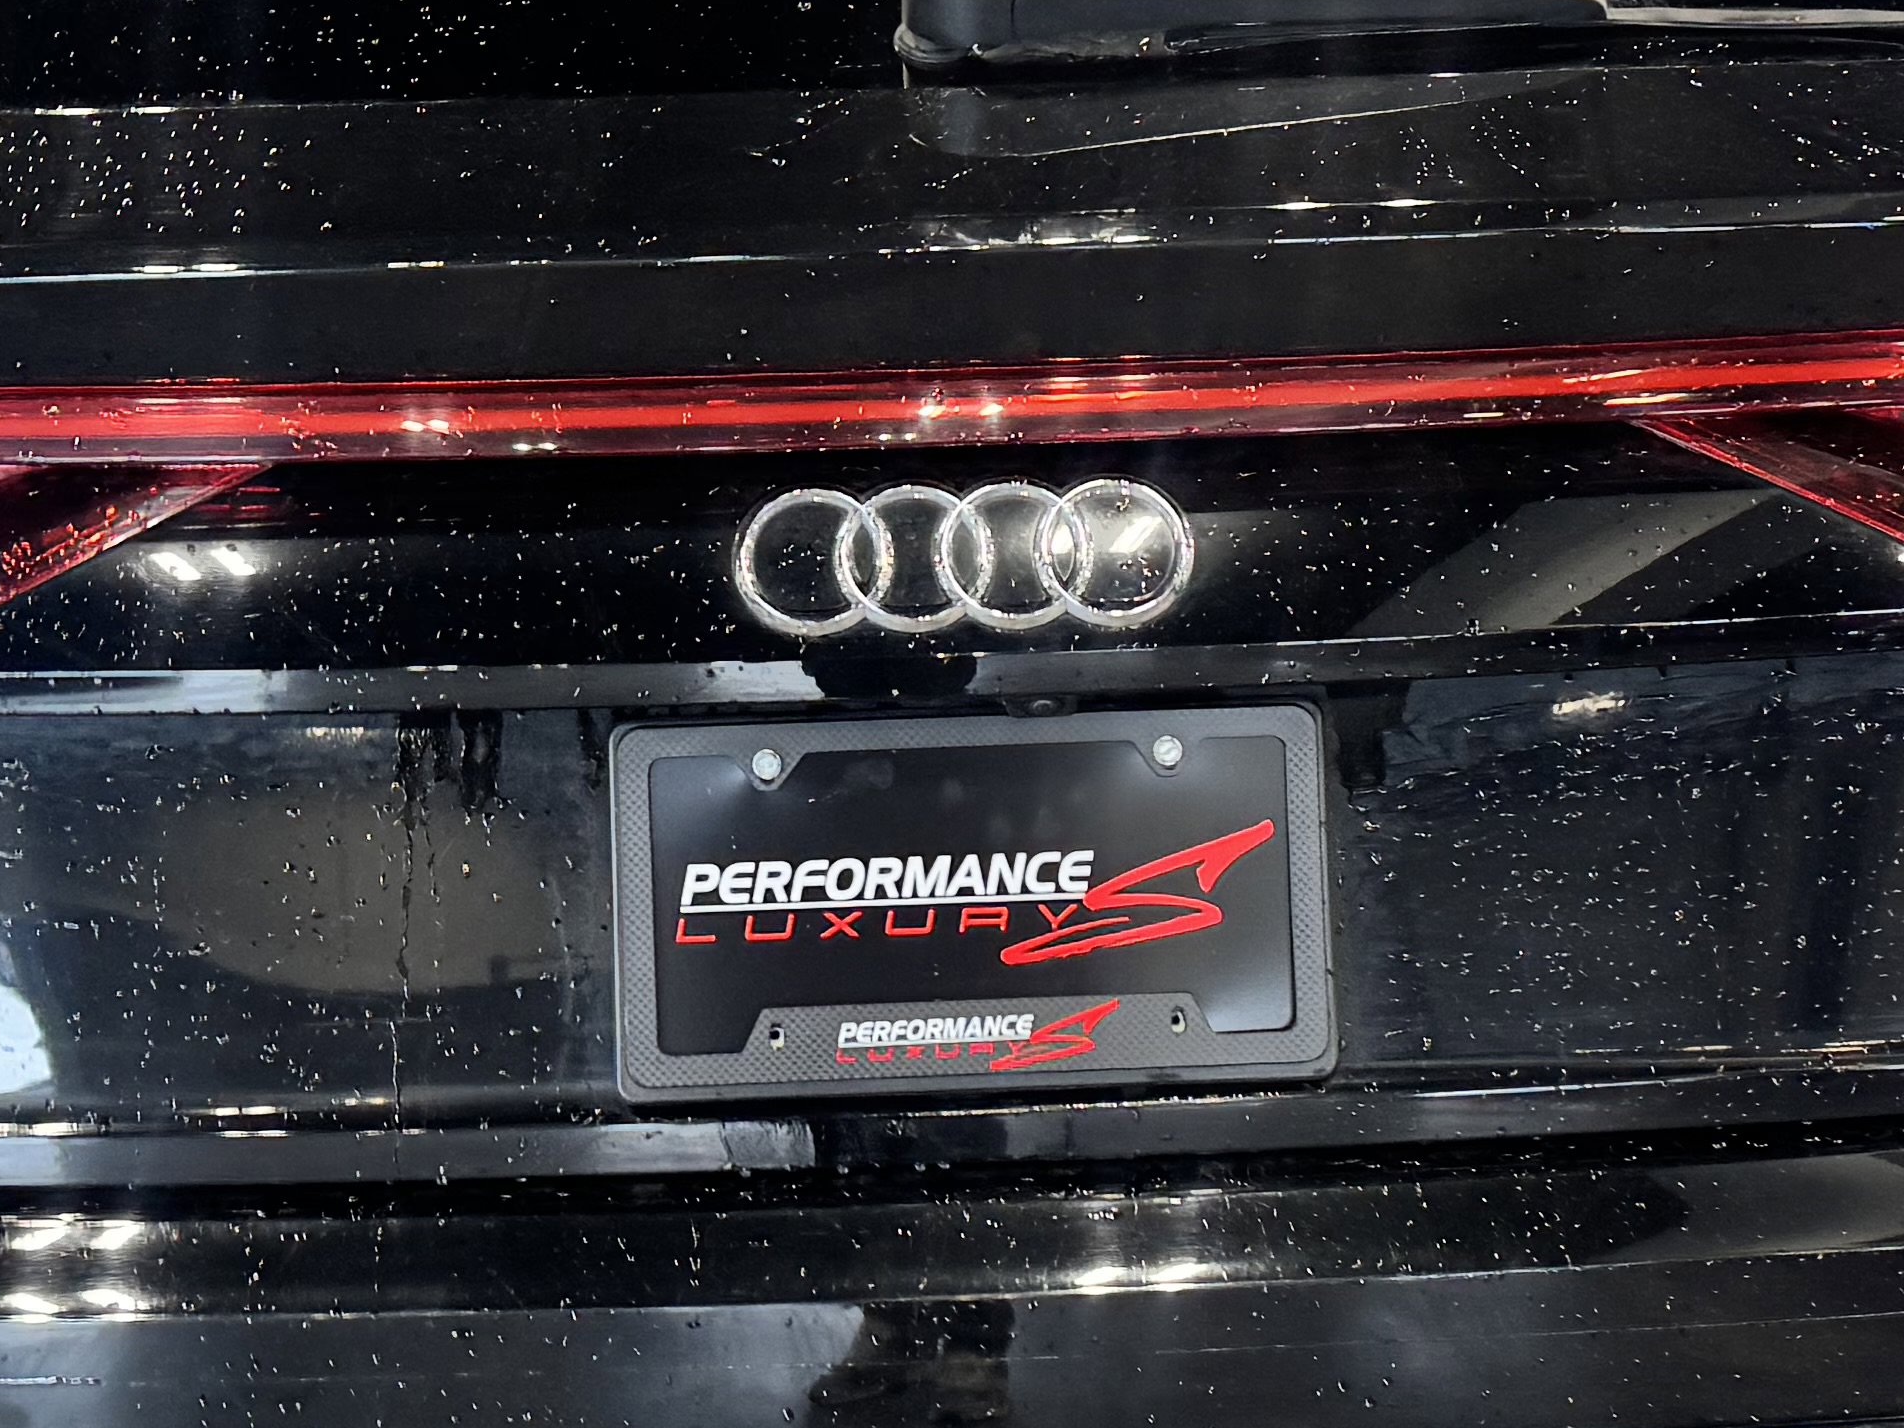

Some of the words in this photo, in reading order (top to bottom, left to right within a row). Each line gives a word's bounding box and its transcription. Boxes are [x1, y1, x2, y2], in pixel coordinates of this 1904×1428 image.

[680, 849, 1095, 907] PERFORMANCE
[675, 903, 1079, 945] LUXURY
[838, 1013, 1035, 1045] PERFORMANCE
